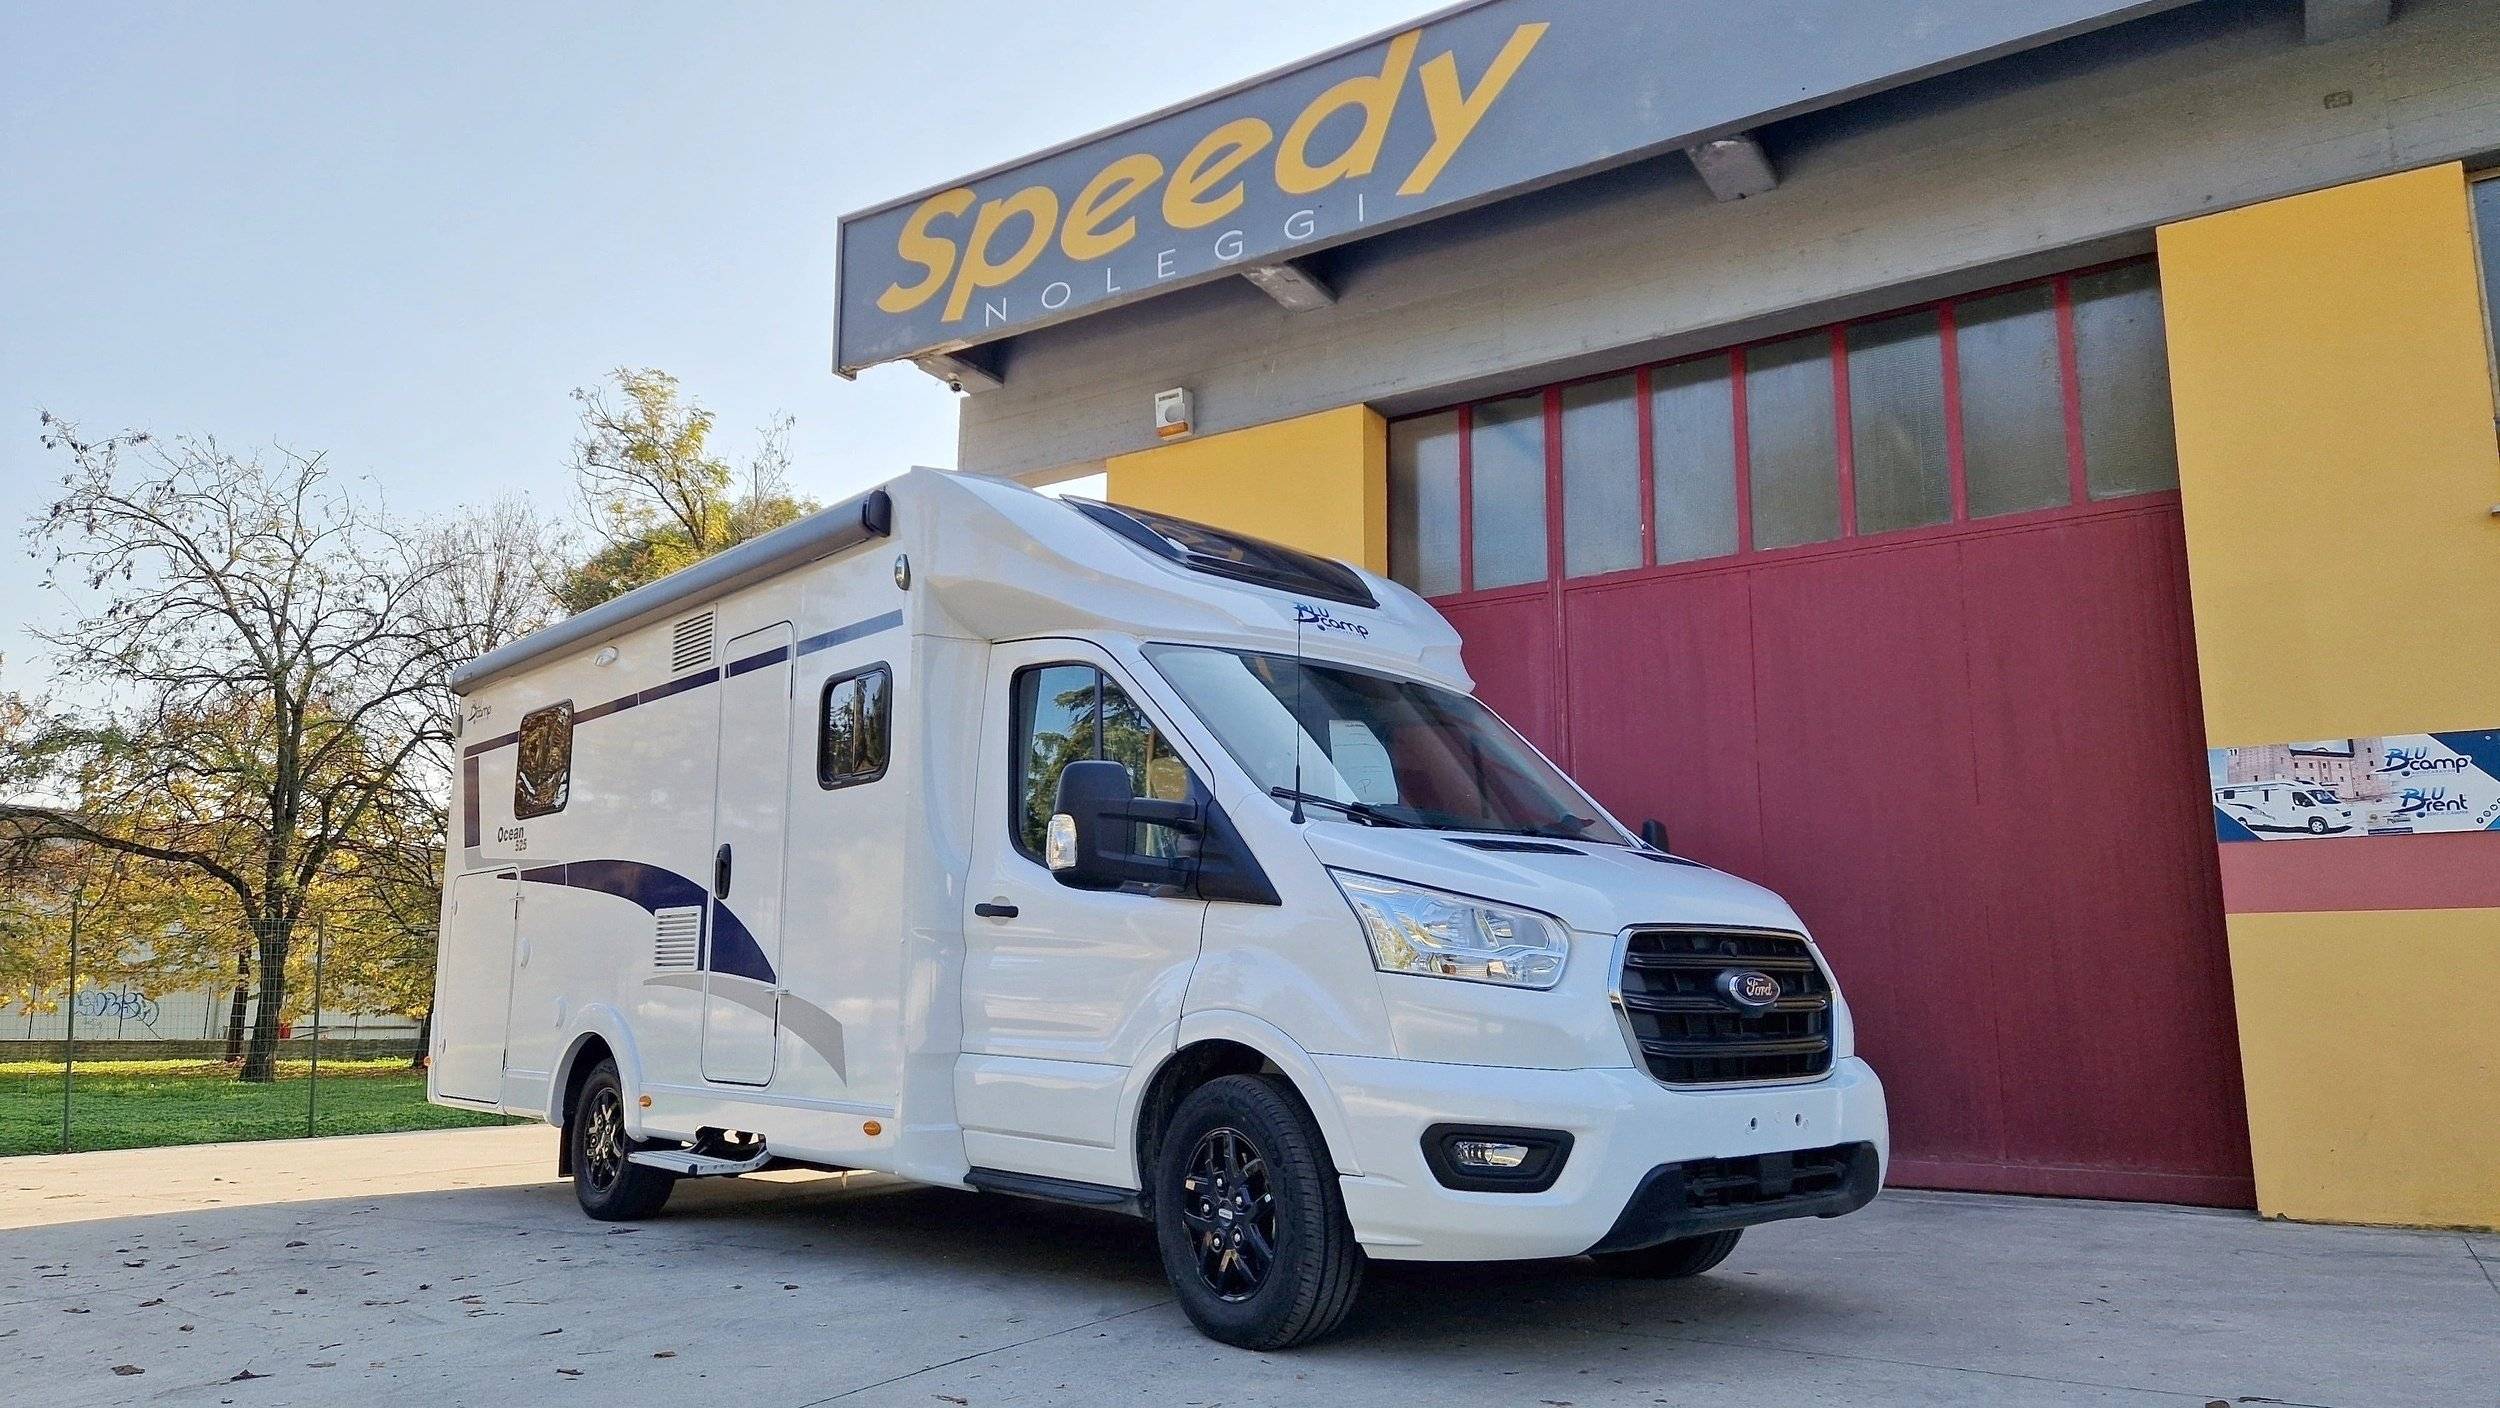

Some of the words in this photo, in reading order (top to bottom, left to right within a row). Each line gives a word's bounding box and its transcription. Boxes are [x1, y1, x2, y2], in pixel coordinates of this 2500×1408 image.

[985, 193, 1365, 328] NOLEGGI
[1320, 617, 1369, 640] camp
[2375, 746, 2428, 773] BLU
[2410, 757, 2469, 774] camp
[2390, 786, 2445, 814] BLU
[2426, 793, 2468, 812] rent
[497, 826, 524, 843] Ocean
[1746, 976, 1773, 997] Ford
